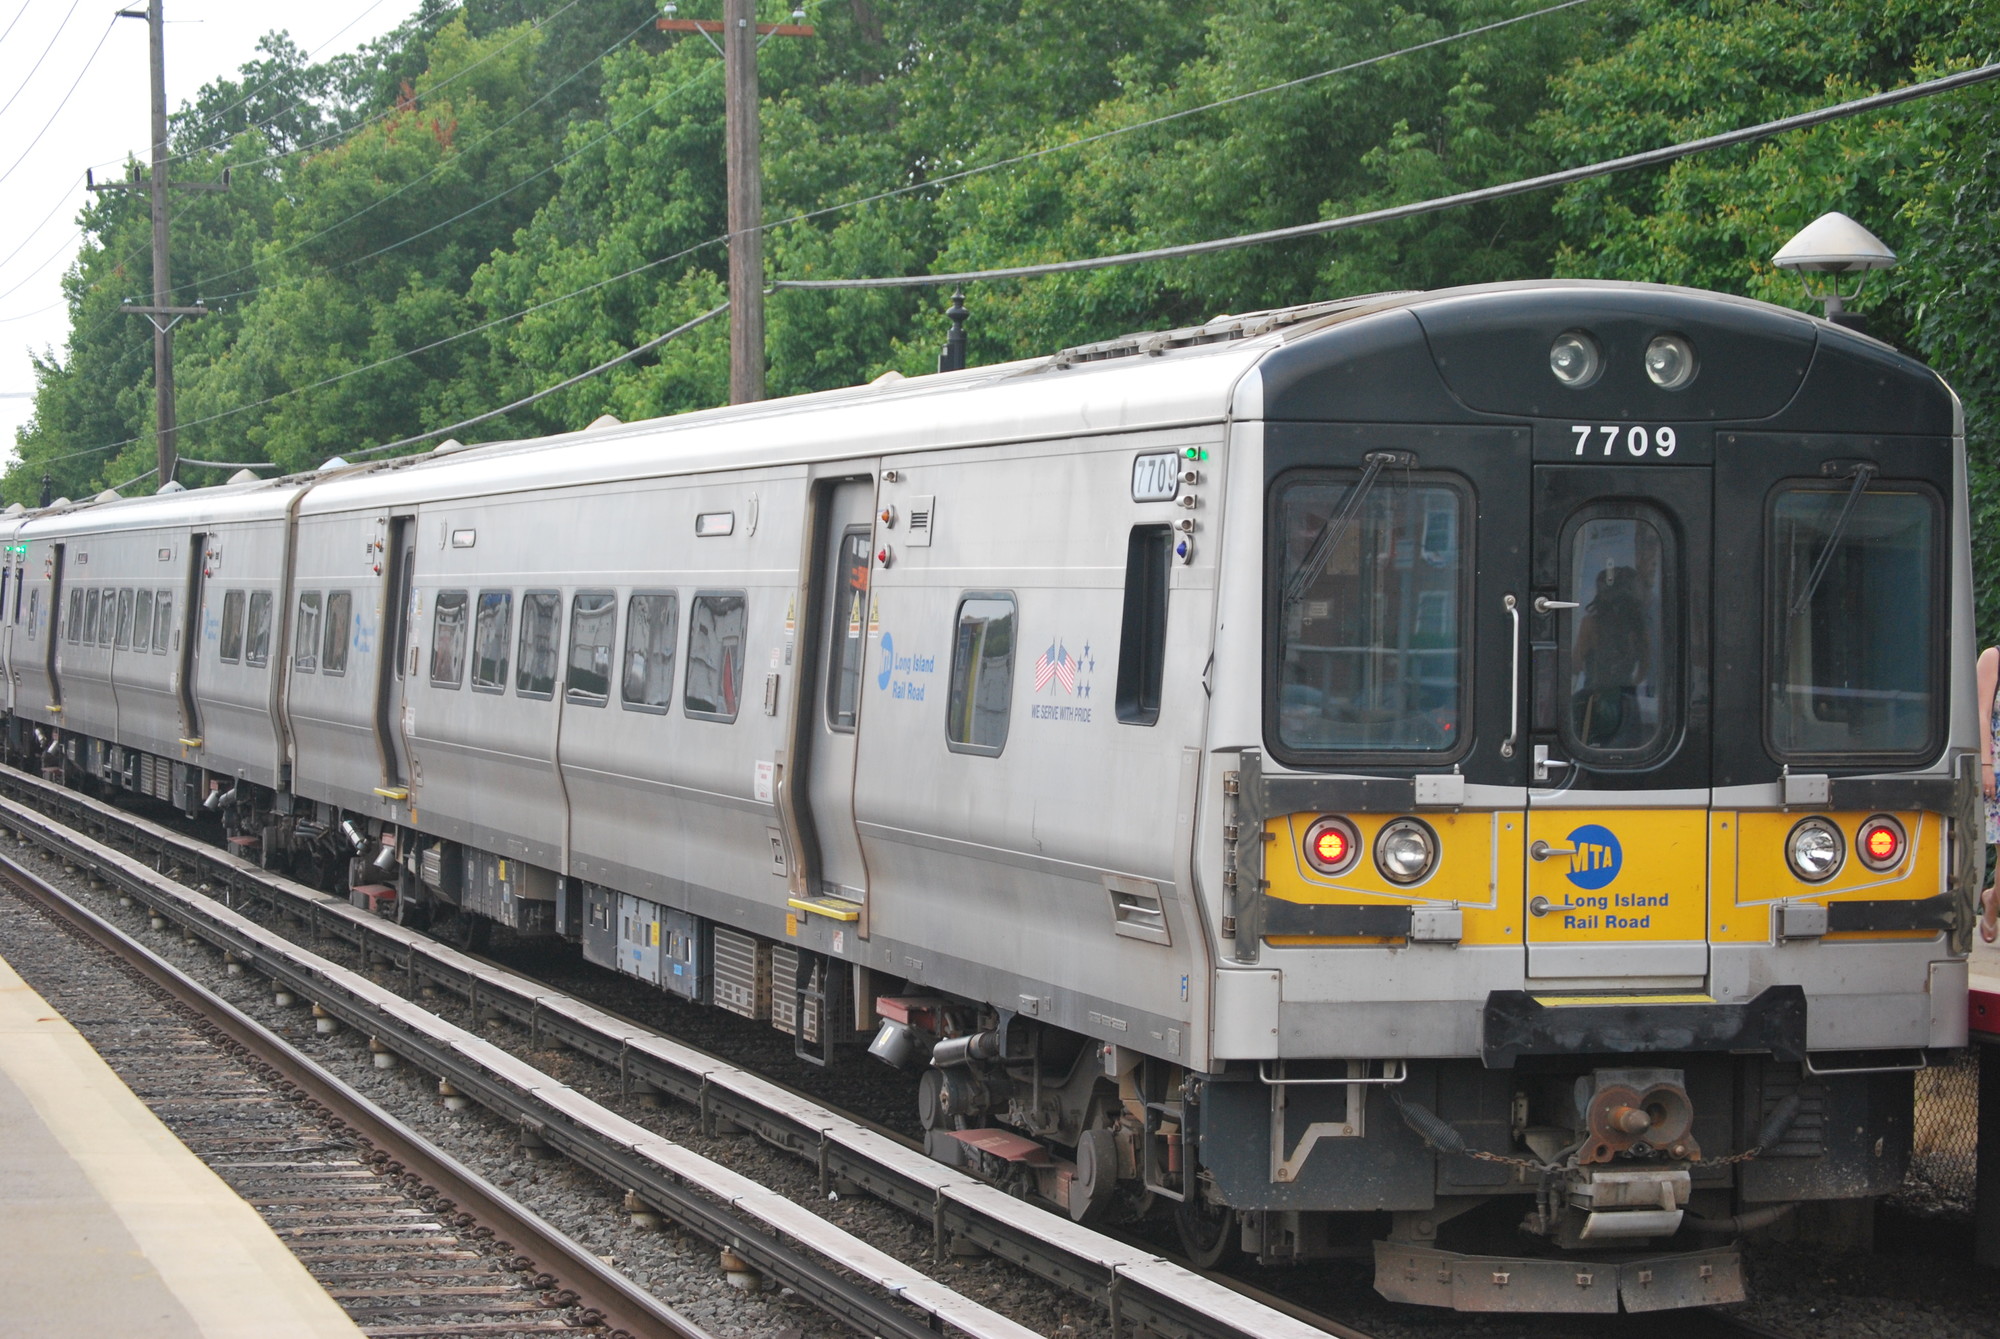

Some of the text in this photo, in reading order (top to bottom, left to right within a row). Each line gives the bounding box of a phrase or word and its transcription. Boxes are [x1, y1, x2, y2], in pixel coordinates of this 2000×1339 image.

[1571, 425, 1677, 457] 7709
[1137, 457, 1176, 493] 7709
[895, 652, 911, 675] Long
[912, 653, 935, 673] Island
[892, 681, 925, 701] Rail Road
[1031, 704, 1092, 723] WE SERVE WITH PRIDE
[1566, 840, 1613, 873] MTA
[1564, 893, 1669, 910] Long Island
[1564, 915, 1651, 929] Rail Road
